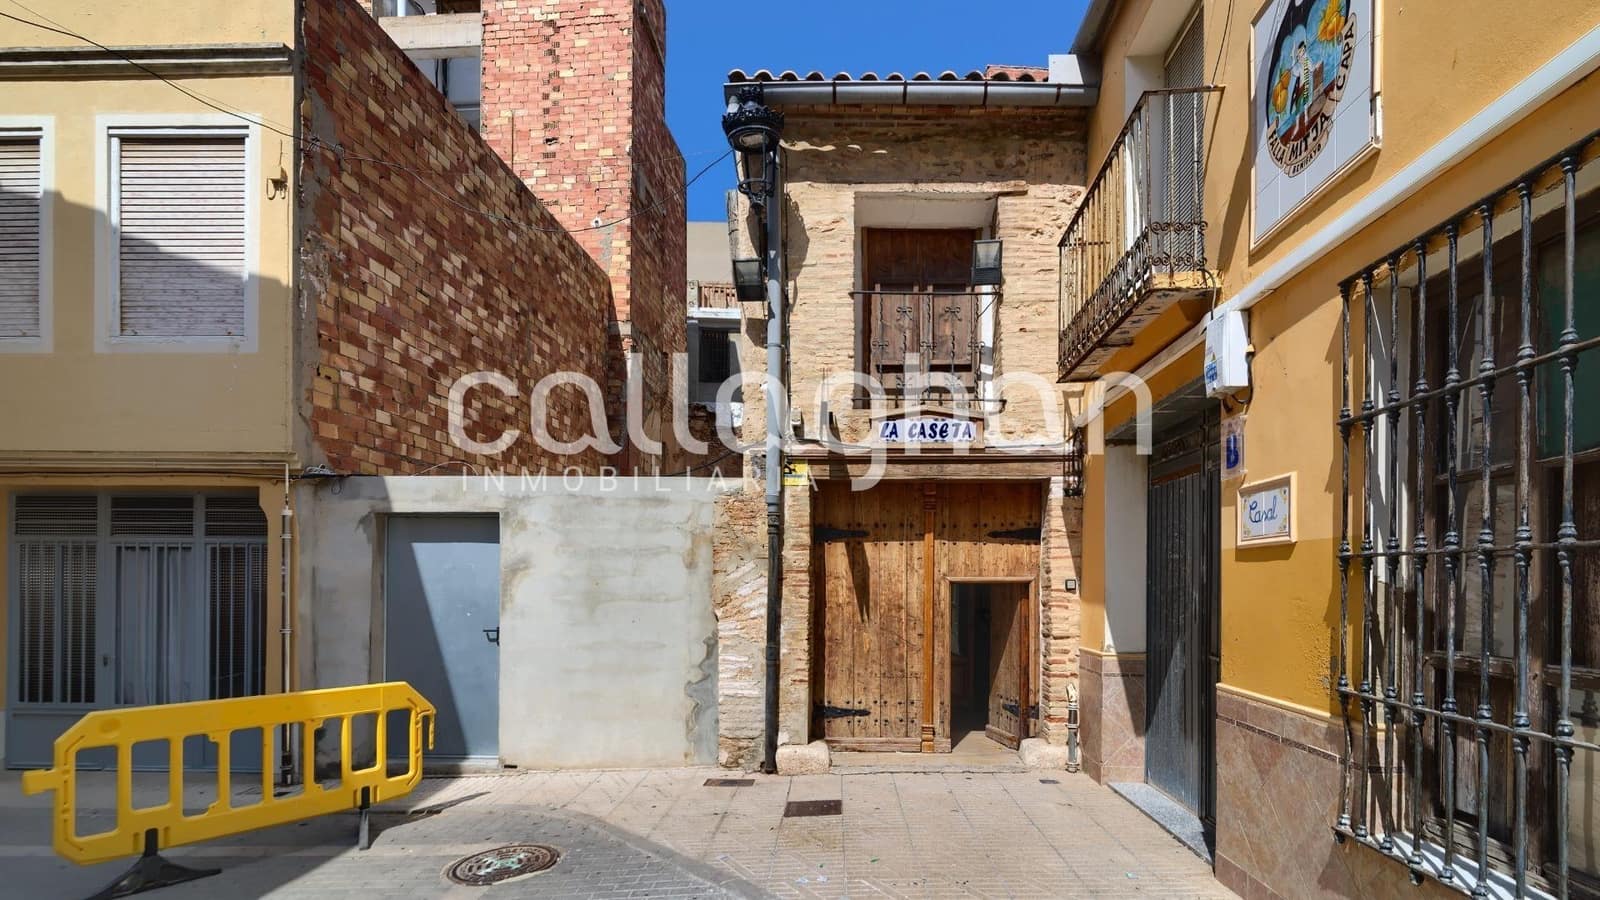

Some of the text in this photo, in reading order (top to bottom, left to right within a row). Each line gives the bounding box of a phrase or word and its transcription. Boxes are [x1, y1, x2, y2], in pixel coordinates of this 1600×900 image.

[1268, 21, 1355, 165] FALLA MITJA CAPA
[880, 421, 899, 439] LA
[1248, 495, 1278, 524] Casal
